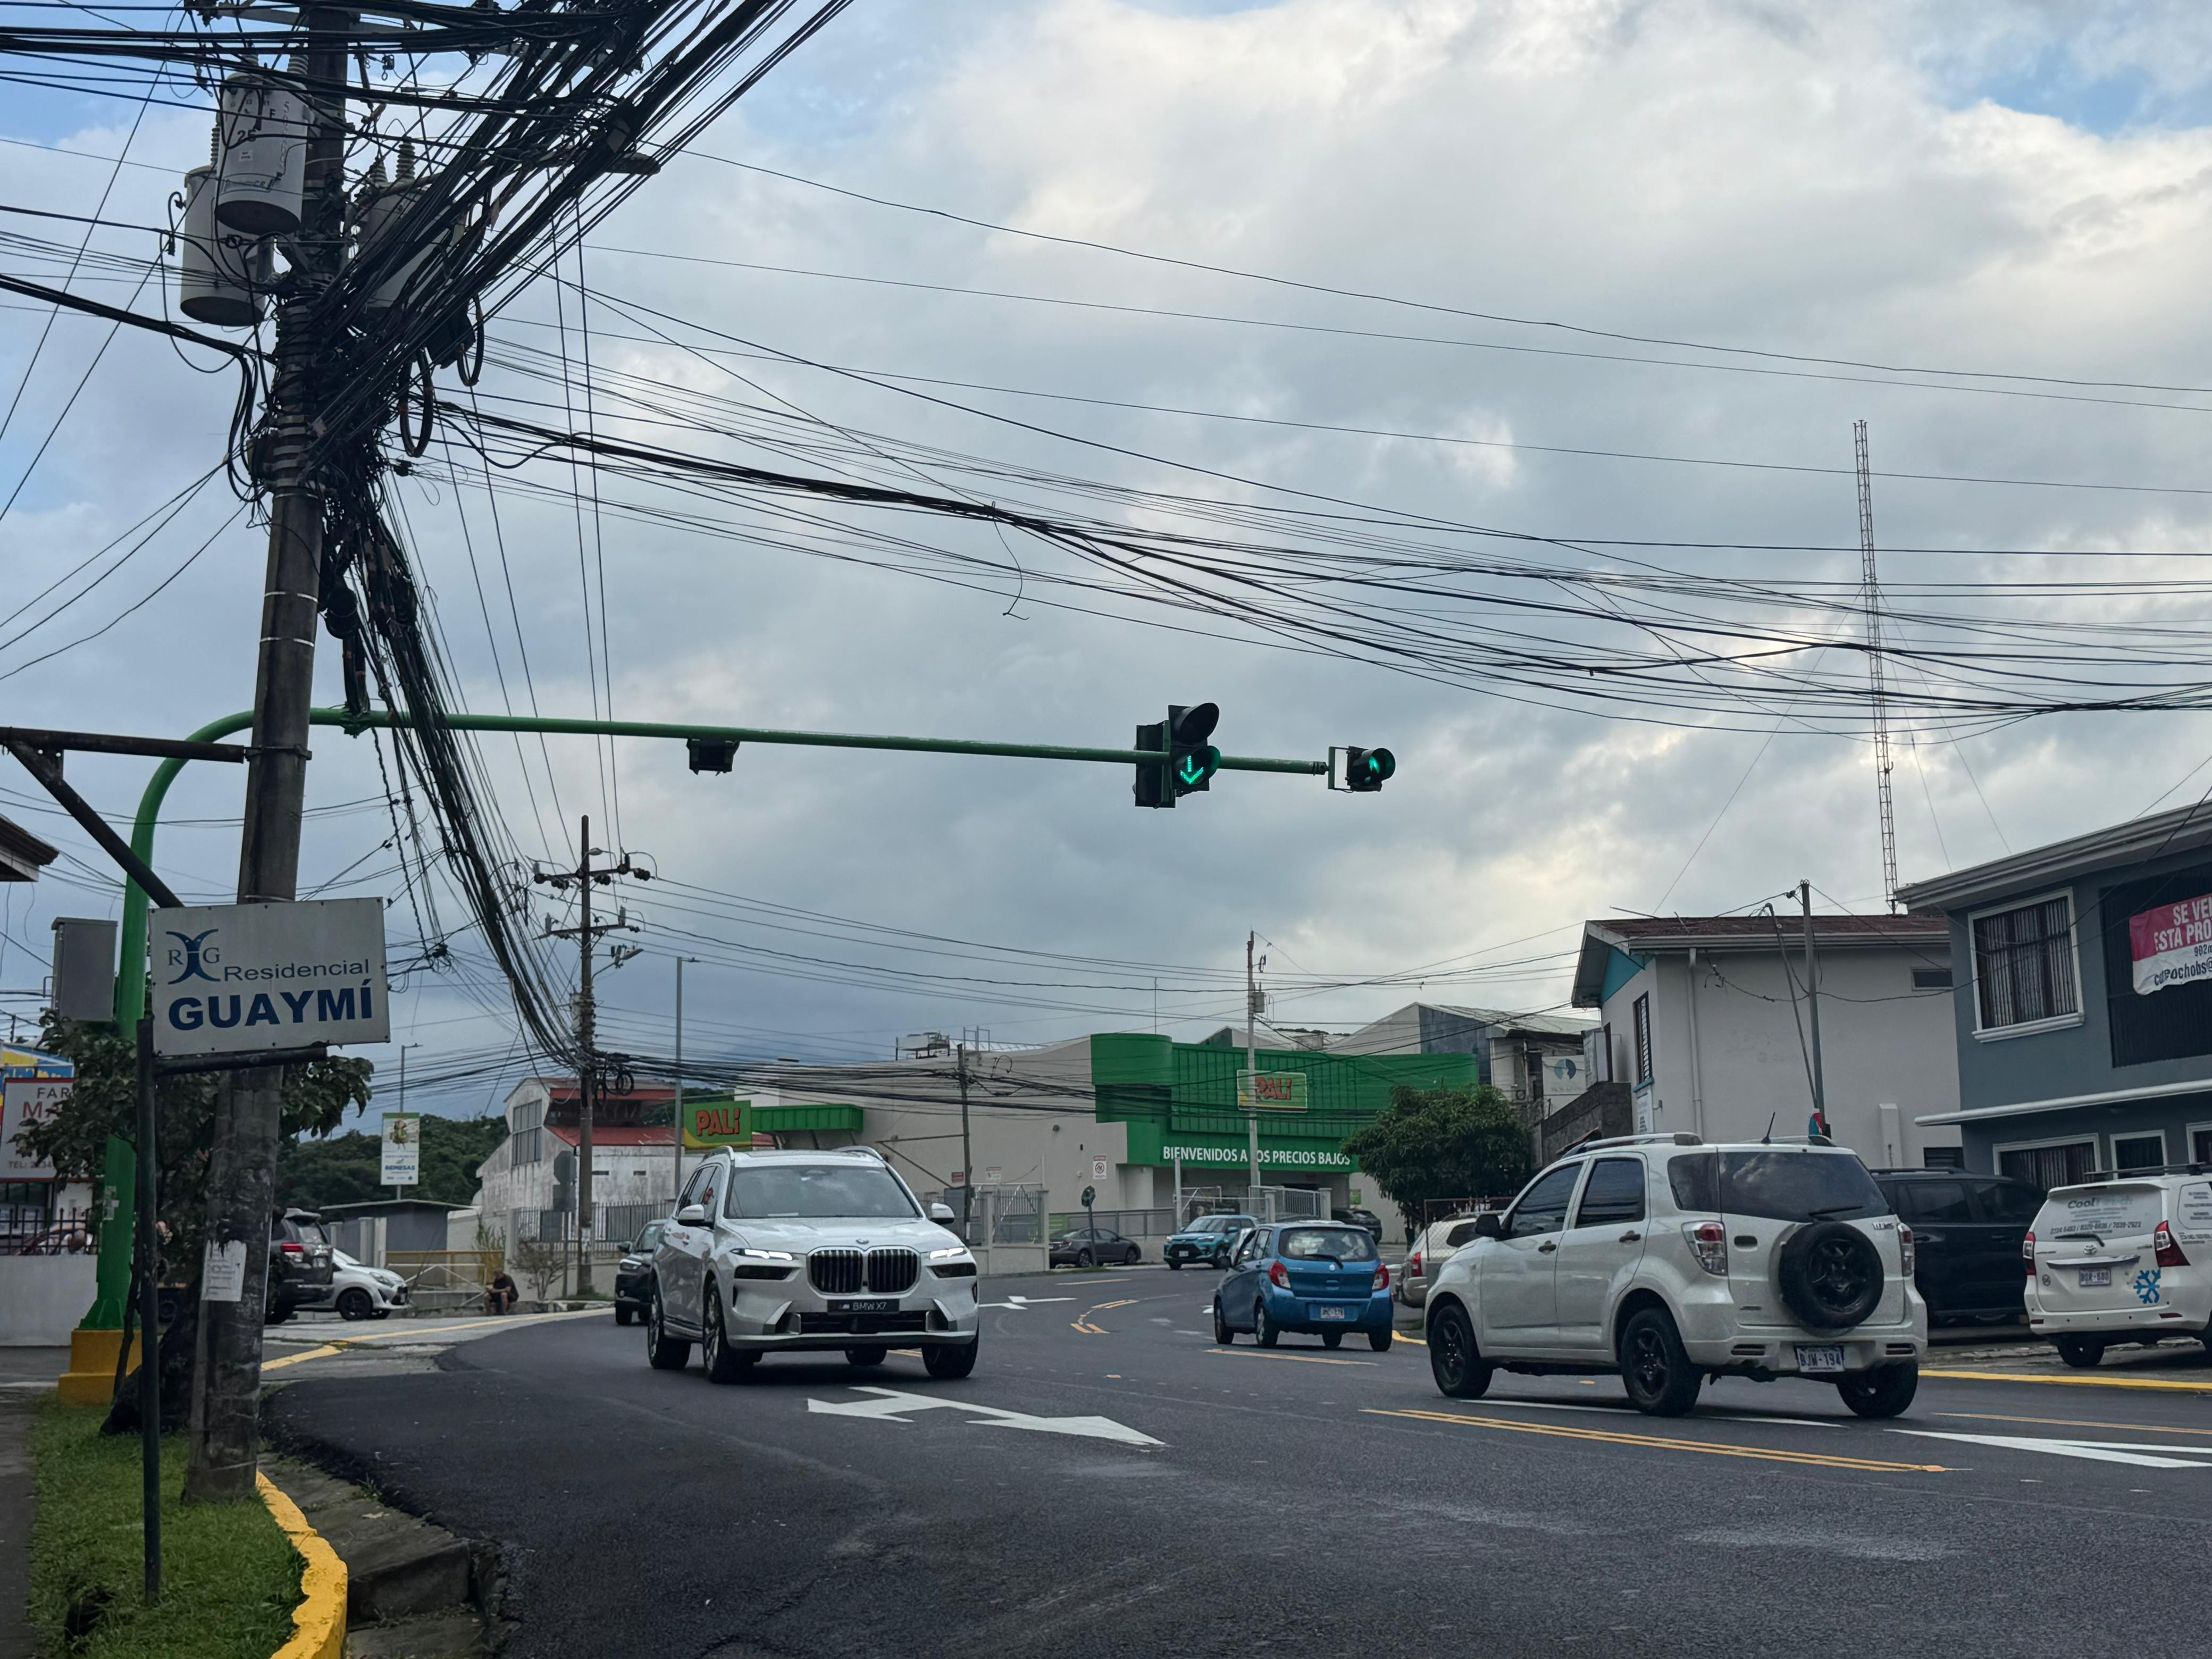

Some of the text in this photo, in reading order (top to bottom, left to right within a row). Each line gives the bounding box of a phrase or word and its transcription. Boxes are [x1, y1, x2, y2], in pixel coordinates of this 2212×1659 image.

[2173, 904, 2190, 926] SE
[2154, 919, 2212, 951] ESTA PRO
[168, 947, 221, 966] R G
[224, 959, 369, 982] Residencial
[169, 978, 372, 1030] GUAYMÍ
[1163, 1146, 1351, 1165] BIENVENIDOS A OS PRECIOS BAJOS
[852, 1302, 887, 1311] BMW X7
